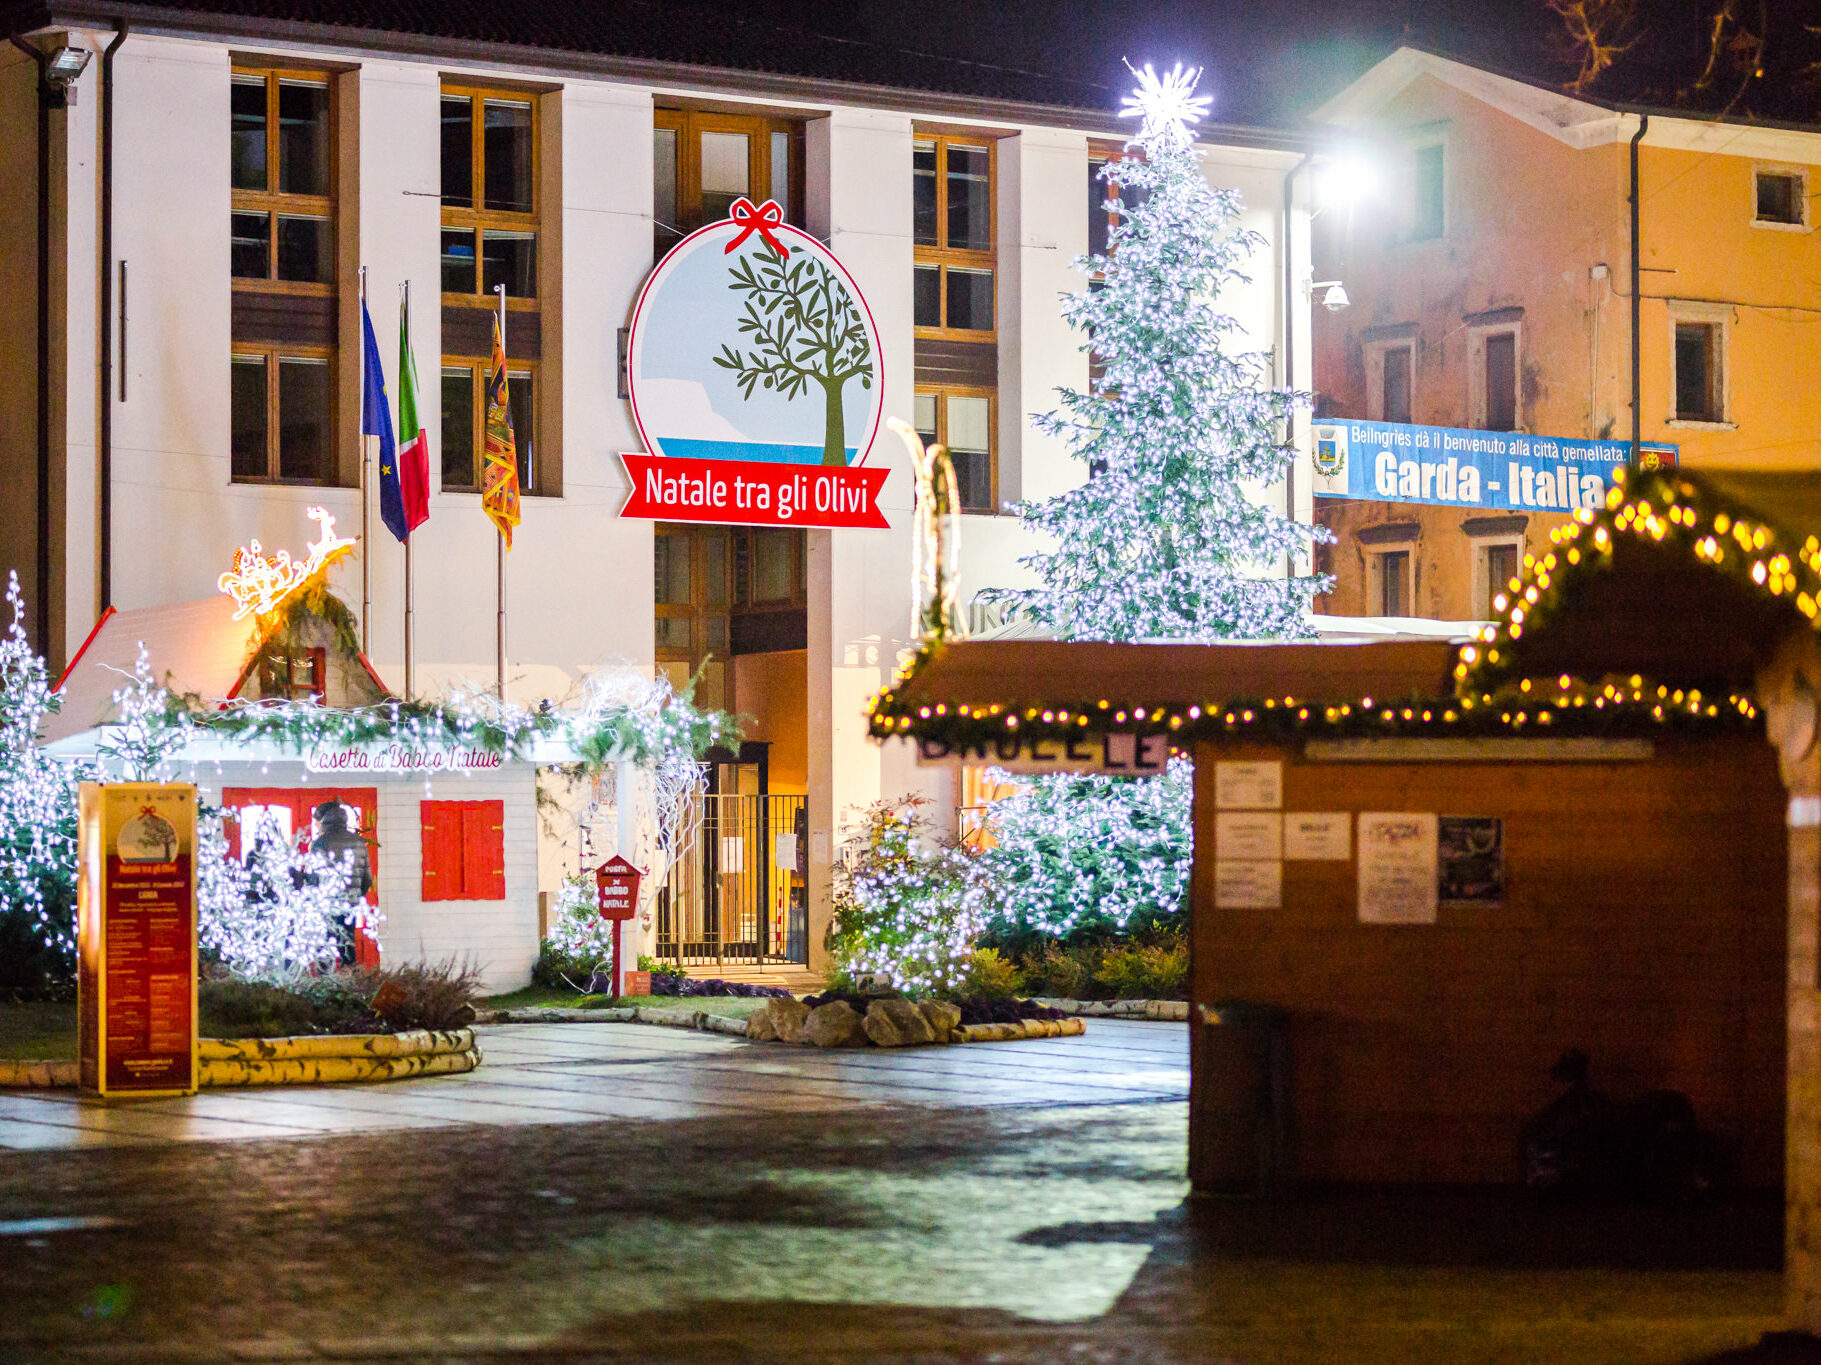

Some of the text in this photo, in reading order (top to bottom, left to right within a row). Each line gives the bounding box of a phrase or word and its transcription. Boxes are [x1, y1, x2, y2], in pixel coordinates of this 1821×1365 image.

[1415, 433, 1430, 449] dà
[1433, 433, 1440, 449] il
[1444, 435, 1506, 455] benvenuto
[1509, 441, 1531, 457] alla
[1533, 441, 1560, 459] città
[1562, 446, 1627, 465] gemellata:
[646, 468, 867, 519] Natale tra gli Olivi
[1375, 452, 1606, 510] Garda - Italia
[373, 752, 385, 768] di
